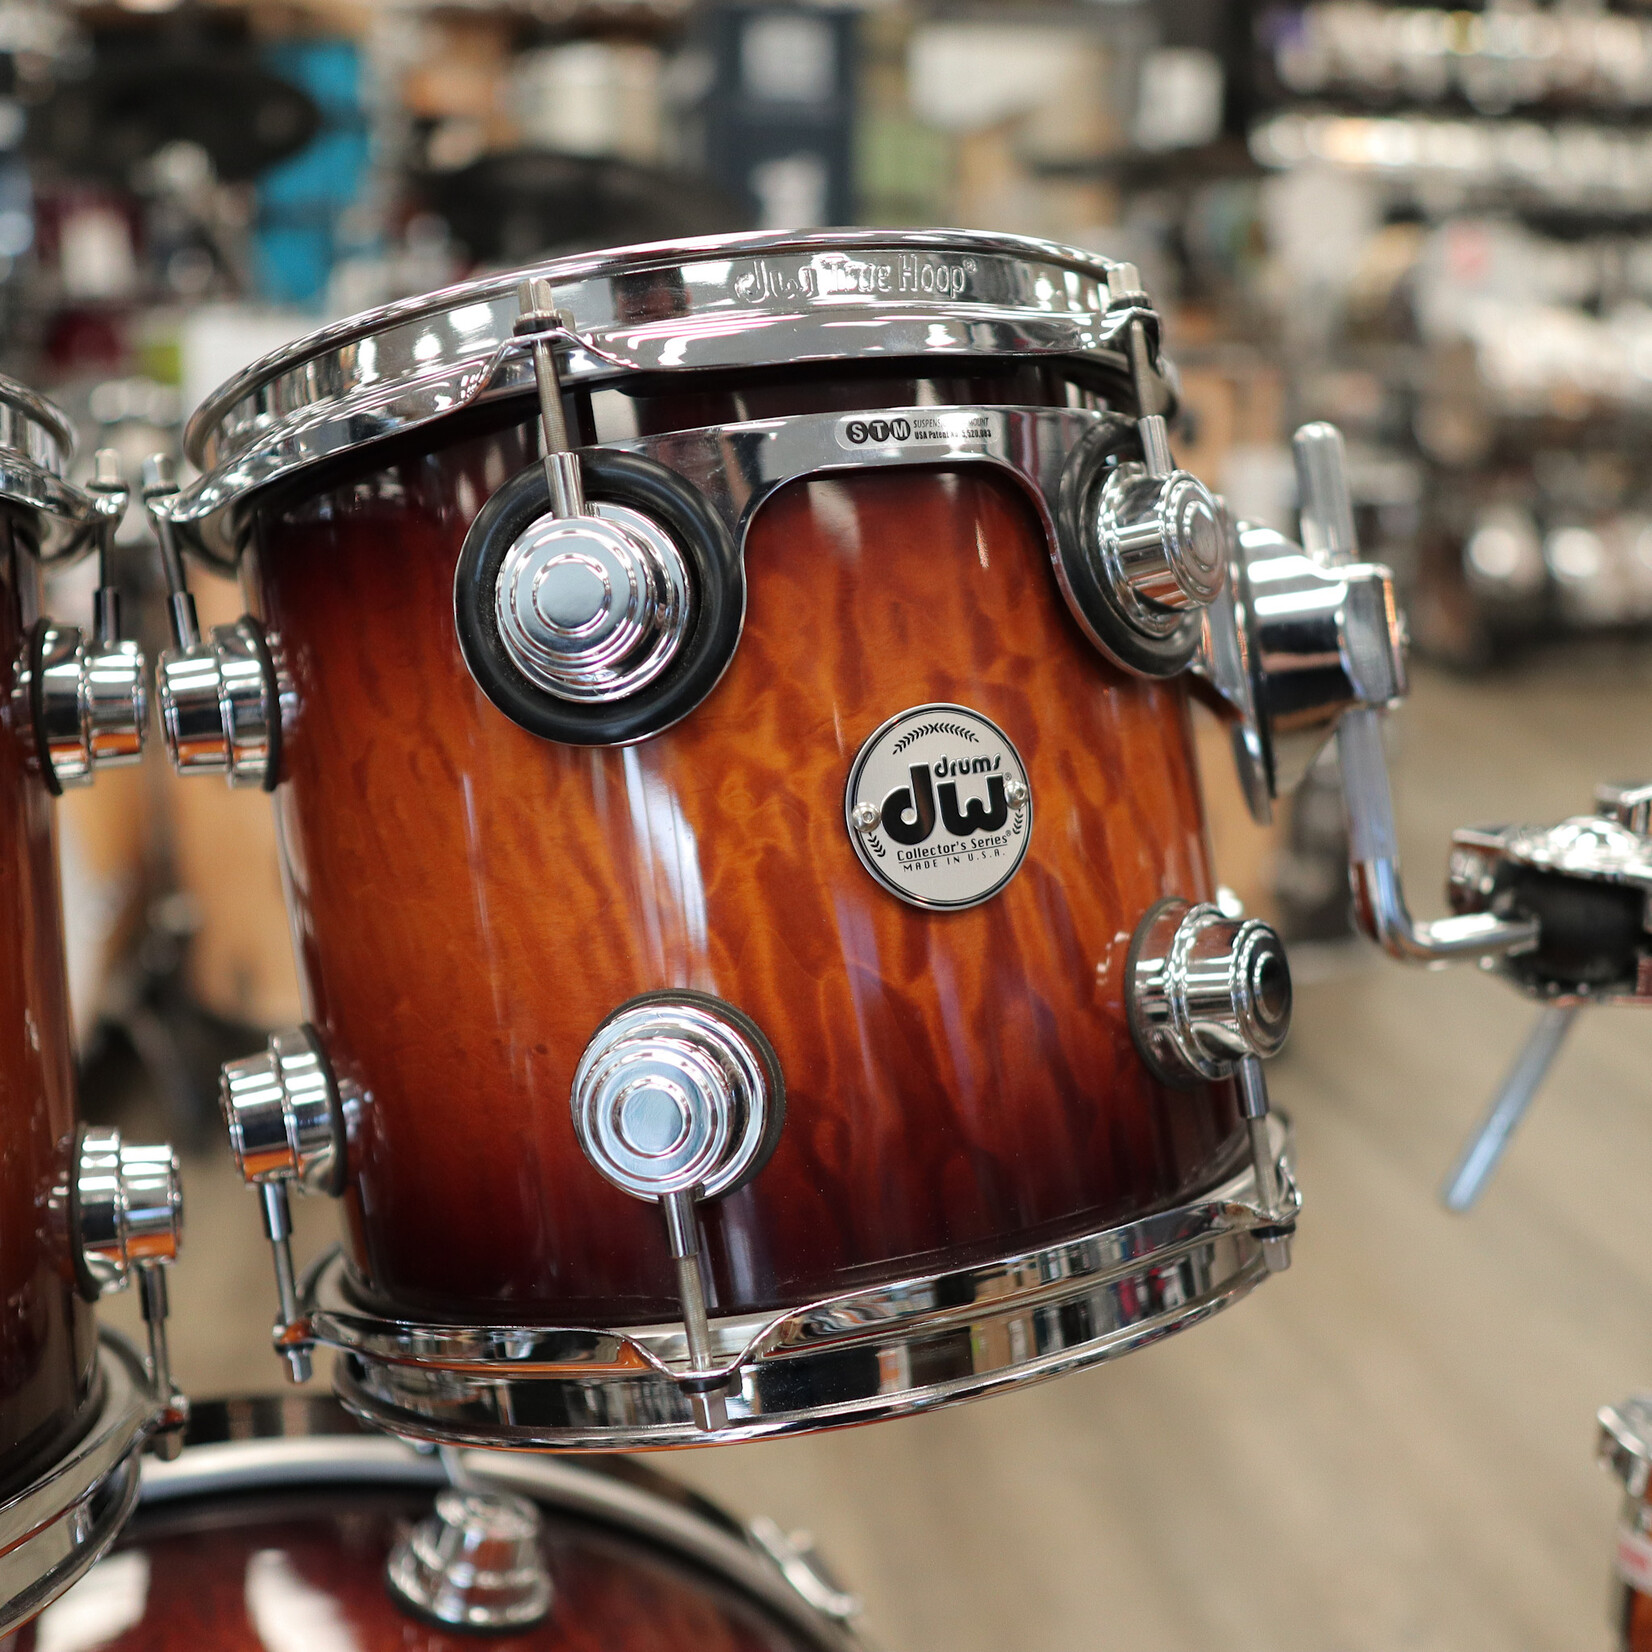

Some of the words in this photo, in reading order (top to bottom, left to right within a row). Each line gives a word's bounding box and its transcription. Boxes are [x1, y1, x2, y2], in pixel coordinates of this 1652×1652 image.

[847, 418, 911, 444] STM
[914, 430, 928, 440] USA
[928, 429, 949, 439] Patent
[933, 754, 1001, 778] drums
[897, 840, 967, 862] Collector's
[903, 859, 938, 873] MADE
[946, 855, 960, 866] IN
[967, 848, 1006, 862] U.S.A.
